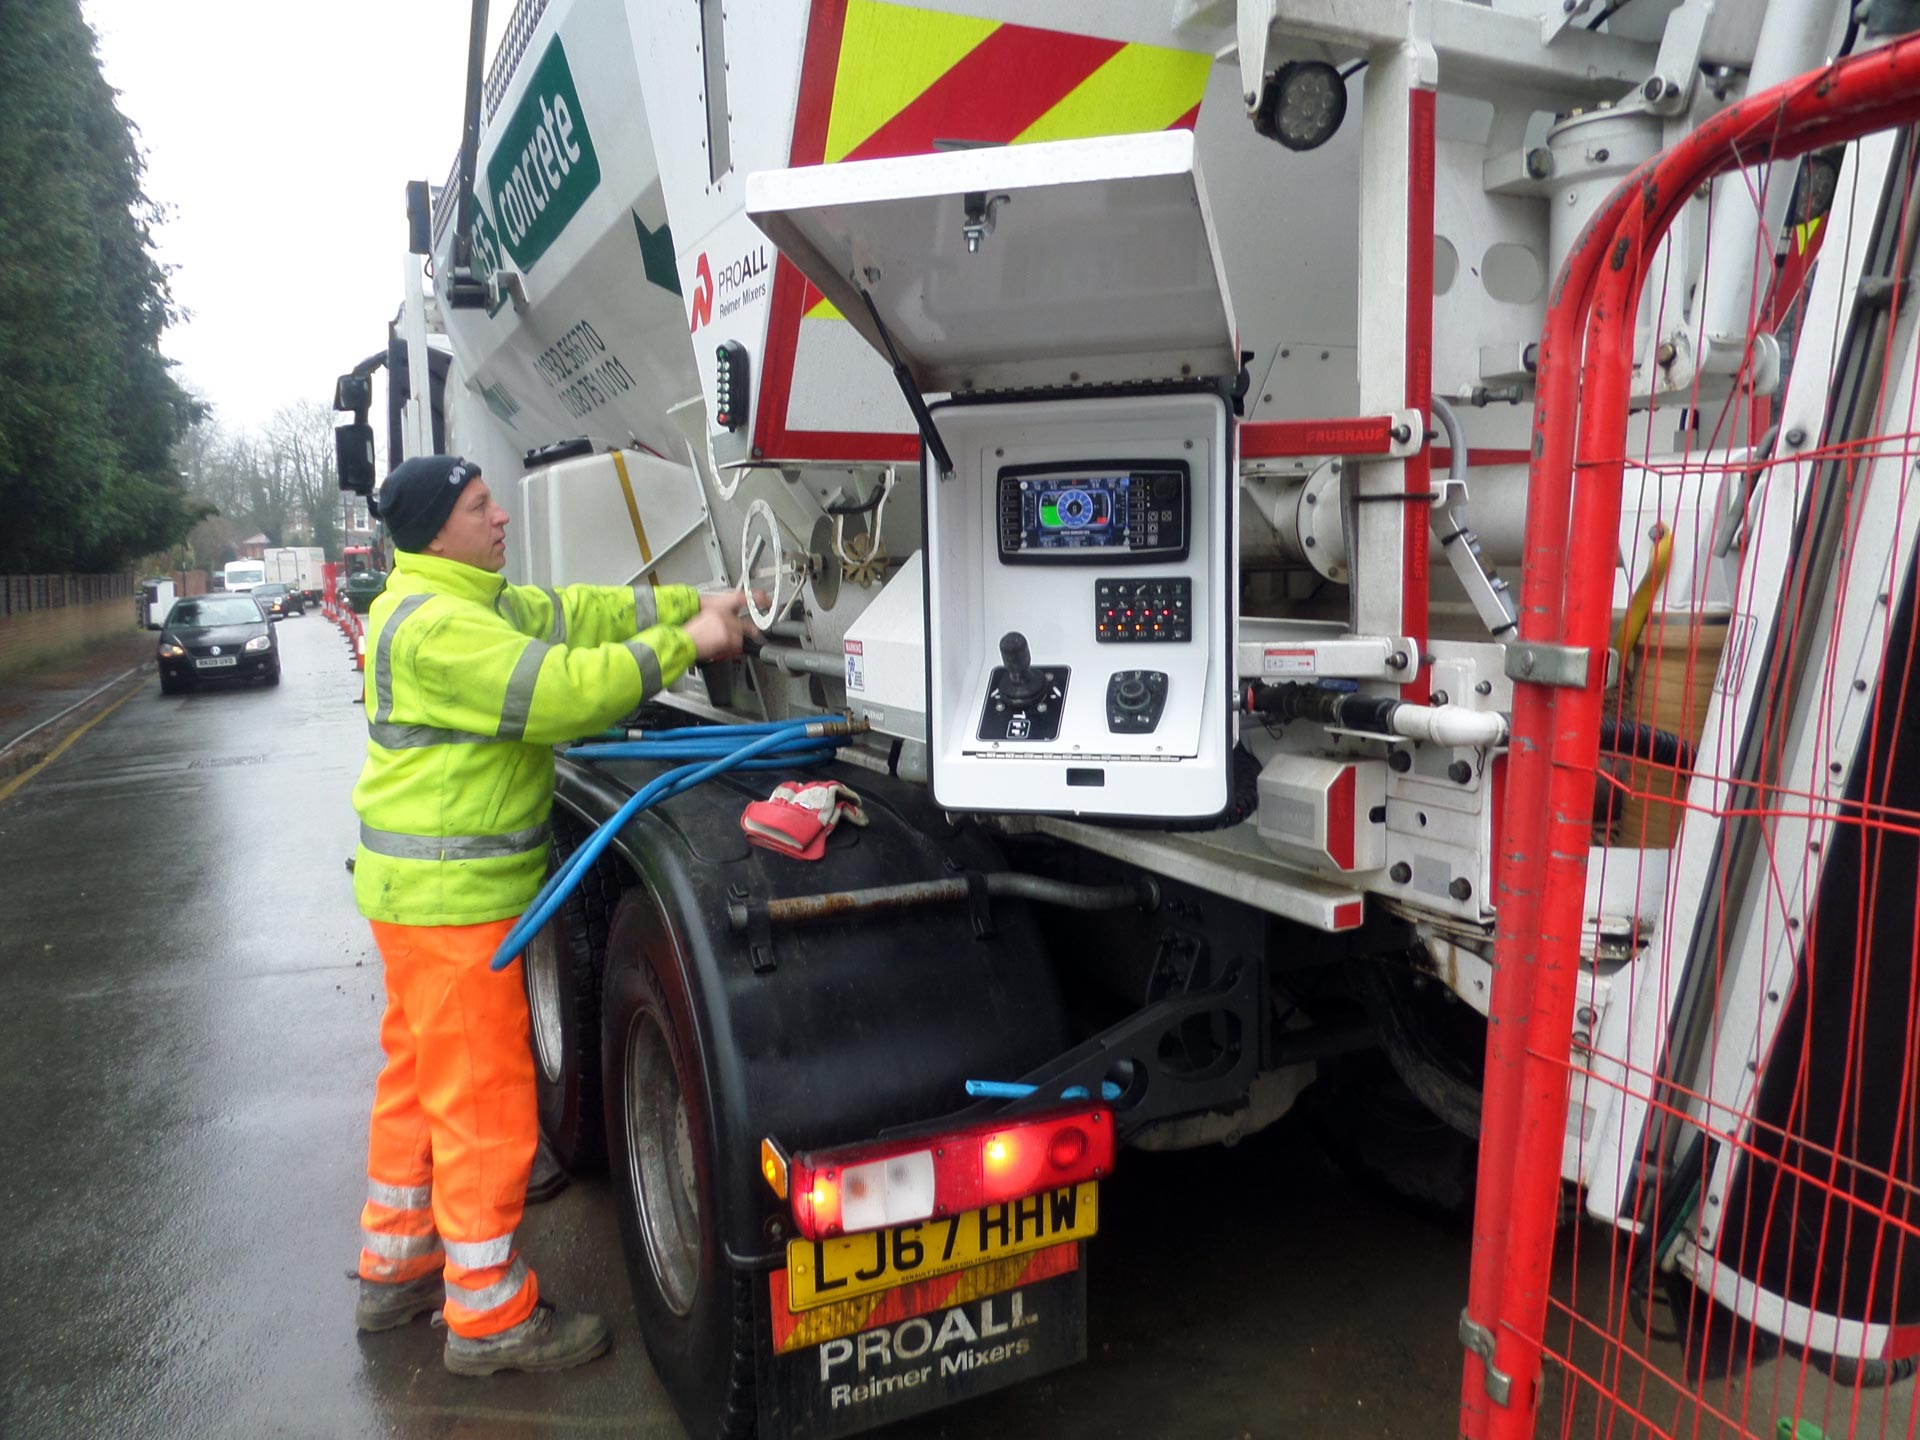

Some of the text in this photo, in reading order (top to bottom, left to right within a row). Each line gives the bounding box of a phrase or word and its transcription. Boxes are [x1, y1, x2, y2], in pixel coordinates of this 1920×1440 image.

[499, 94, 580, 247] concrete
[718, 245, 768, 297] PROALL
[719, 283, 767, 319] Reimer Mixers
[533, 319, 606, 388] 01932 566770
[558, 385, 592, 419] 0208
[1306, 427, 1385, 442] FRUEHAUF
[813, 1186, 1078, 1293] LJ67 HHW
[819, 1291, 1039, 1382] PROALL
[831, 1338, 1031, 1409] Reimer Mixers
